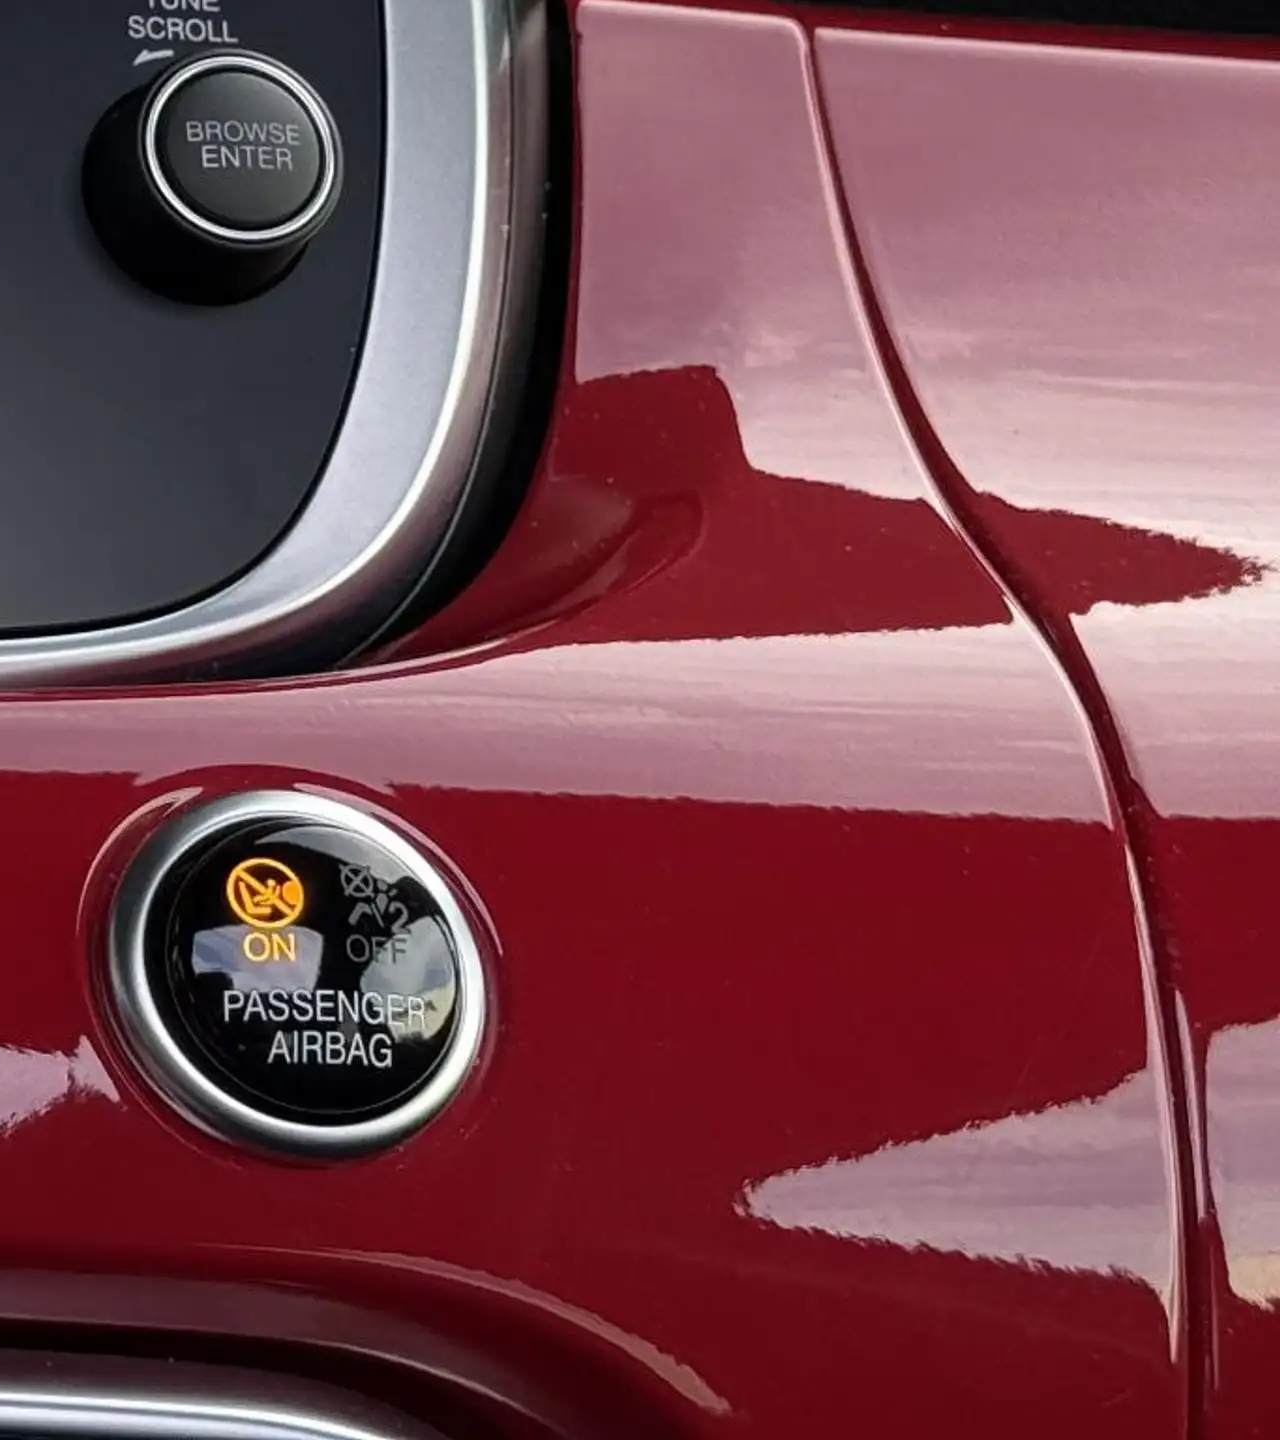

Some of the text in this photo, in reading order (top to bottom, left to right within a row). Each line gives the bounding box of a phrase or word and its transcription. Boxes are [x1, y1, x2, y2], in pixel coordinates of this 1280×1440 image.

[128, 15, 238, 44] SCROLL
[186, 120, 301, 146] BROWSE
[201, 145, 294, 171] ENTER
[242, 932, 297, 962] ON
[345, 934, 408, 964] OFF
[223, 989, 427, 1030] PASSENGER
[267, 1030, 393, 1068] AIRBAG
